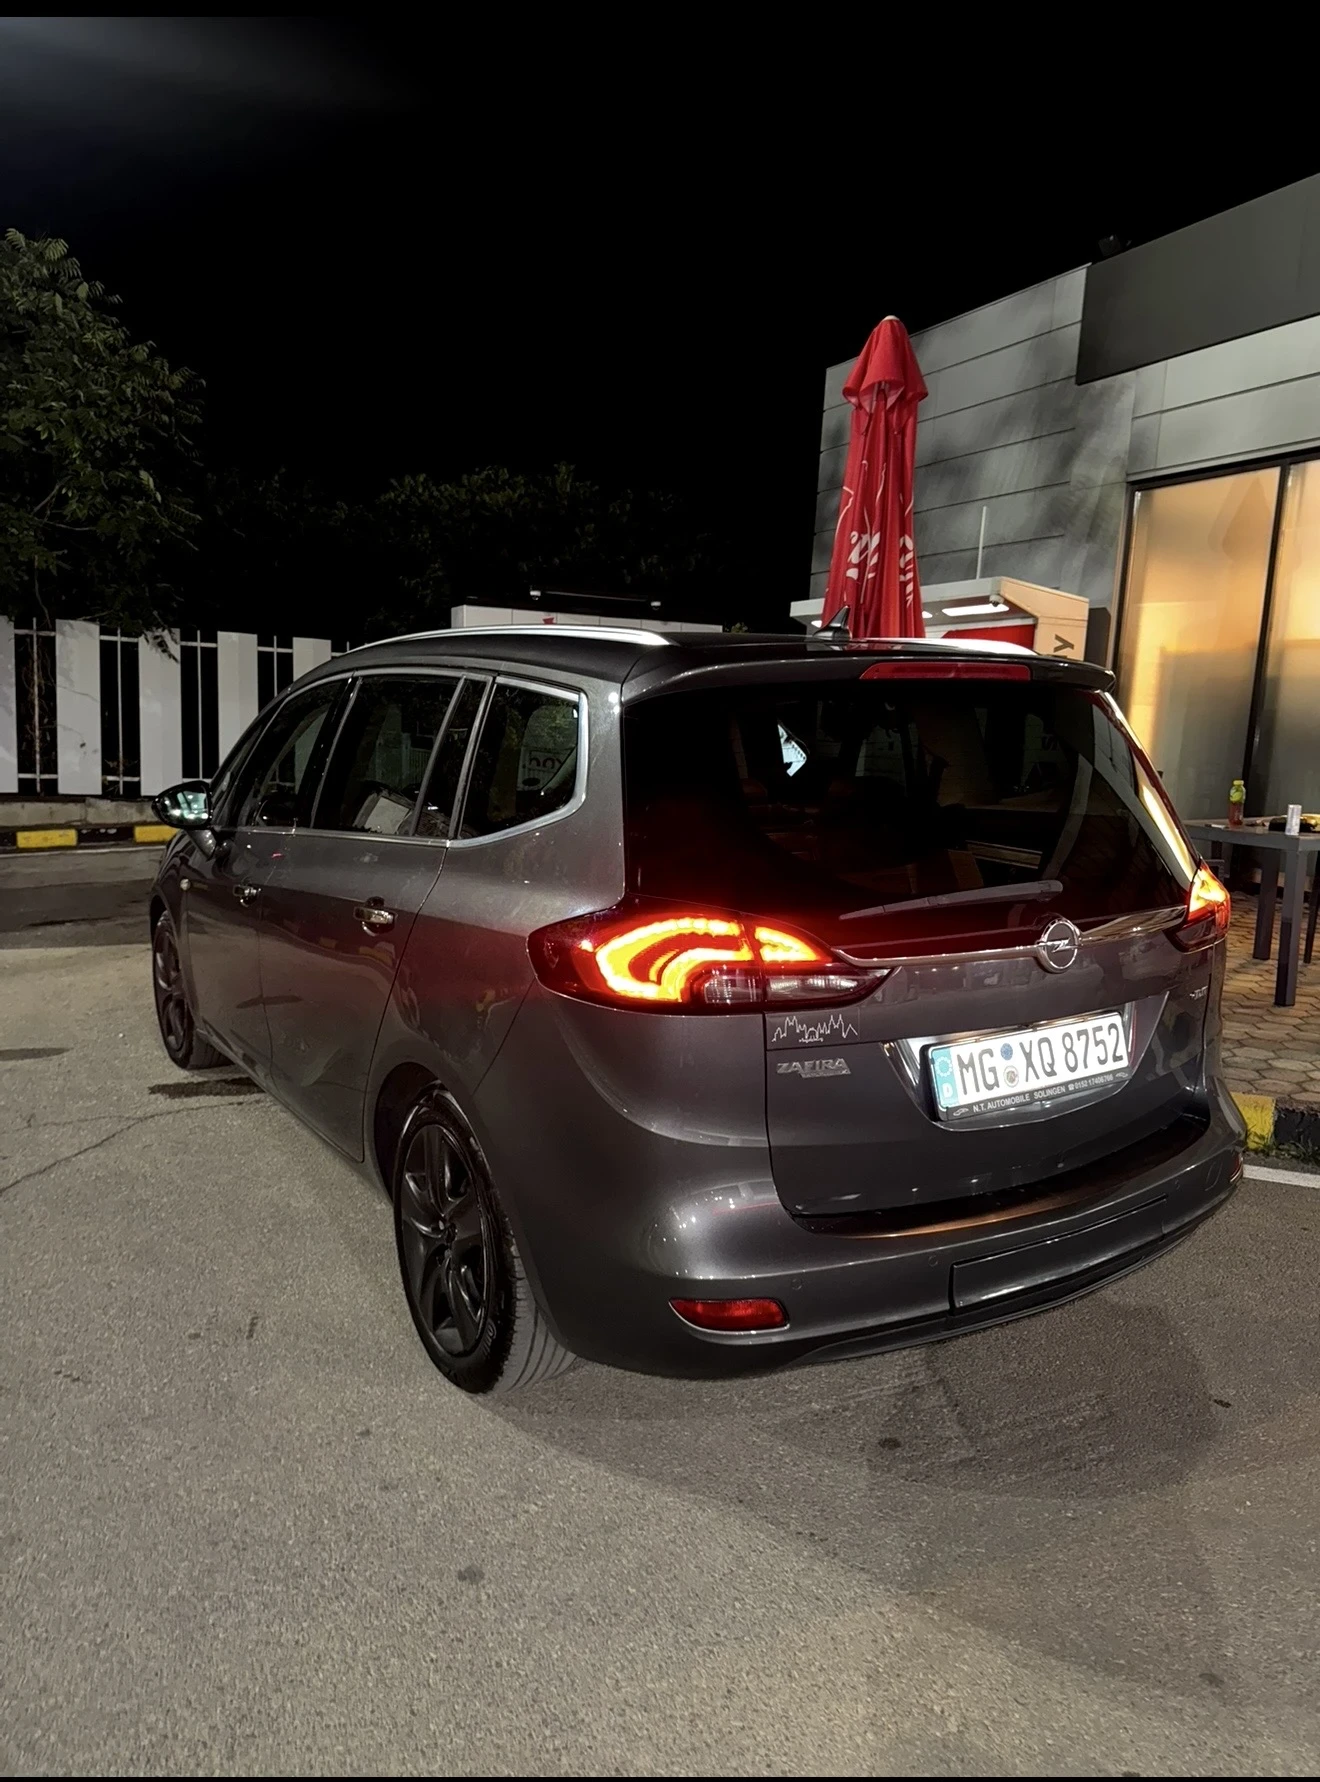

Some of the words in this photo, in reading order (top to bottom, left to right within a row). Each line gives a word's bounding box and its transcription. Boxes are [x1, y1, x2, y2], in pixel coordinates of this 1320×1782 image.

[777, 1058, 850, 1073] ZAFIRA
[957, 1048, 1000, 1095] MG
[1019, 1037, 1057, 1082] XQ
[1062, 1023, 1123, 1073] 8752
[942, 1082, 953, 1098] D
[973, 1103, 986, 1113] N.T.
[987, 1093, 1030, 1109] AUTOMOBILE
[1034, 1086, 1066, 1099] SOLINGEN
